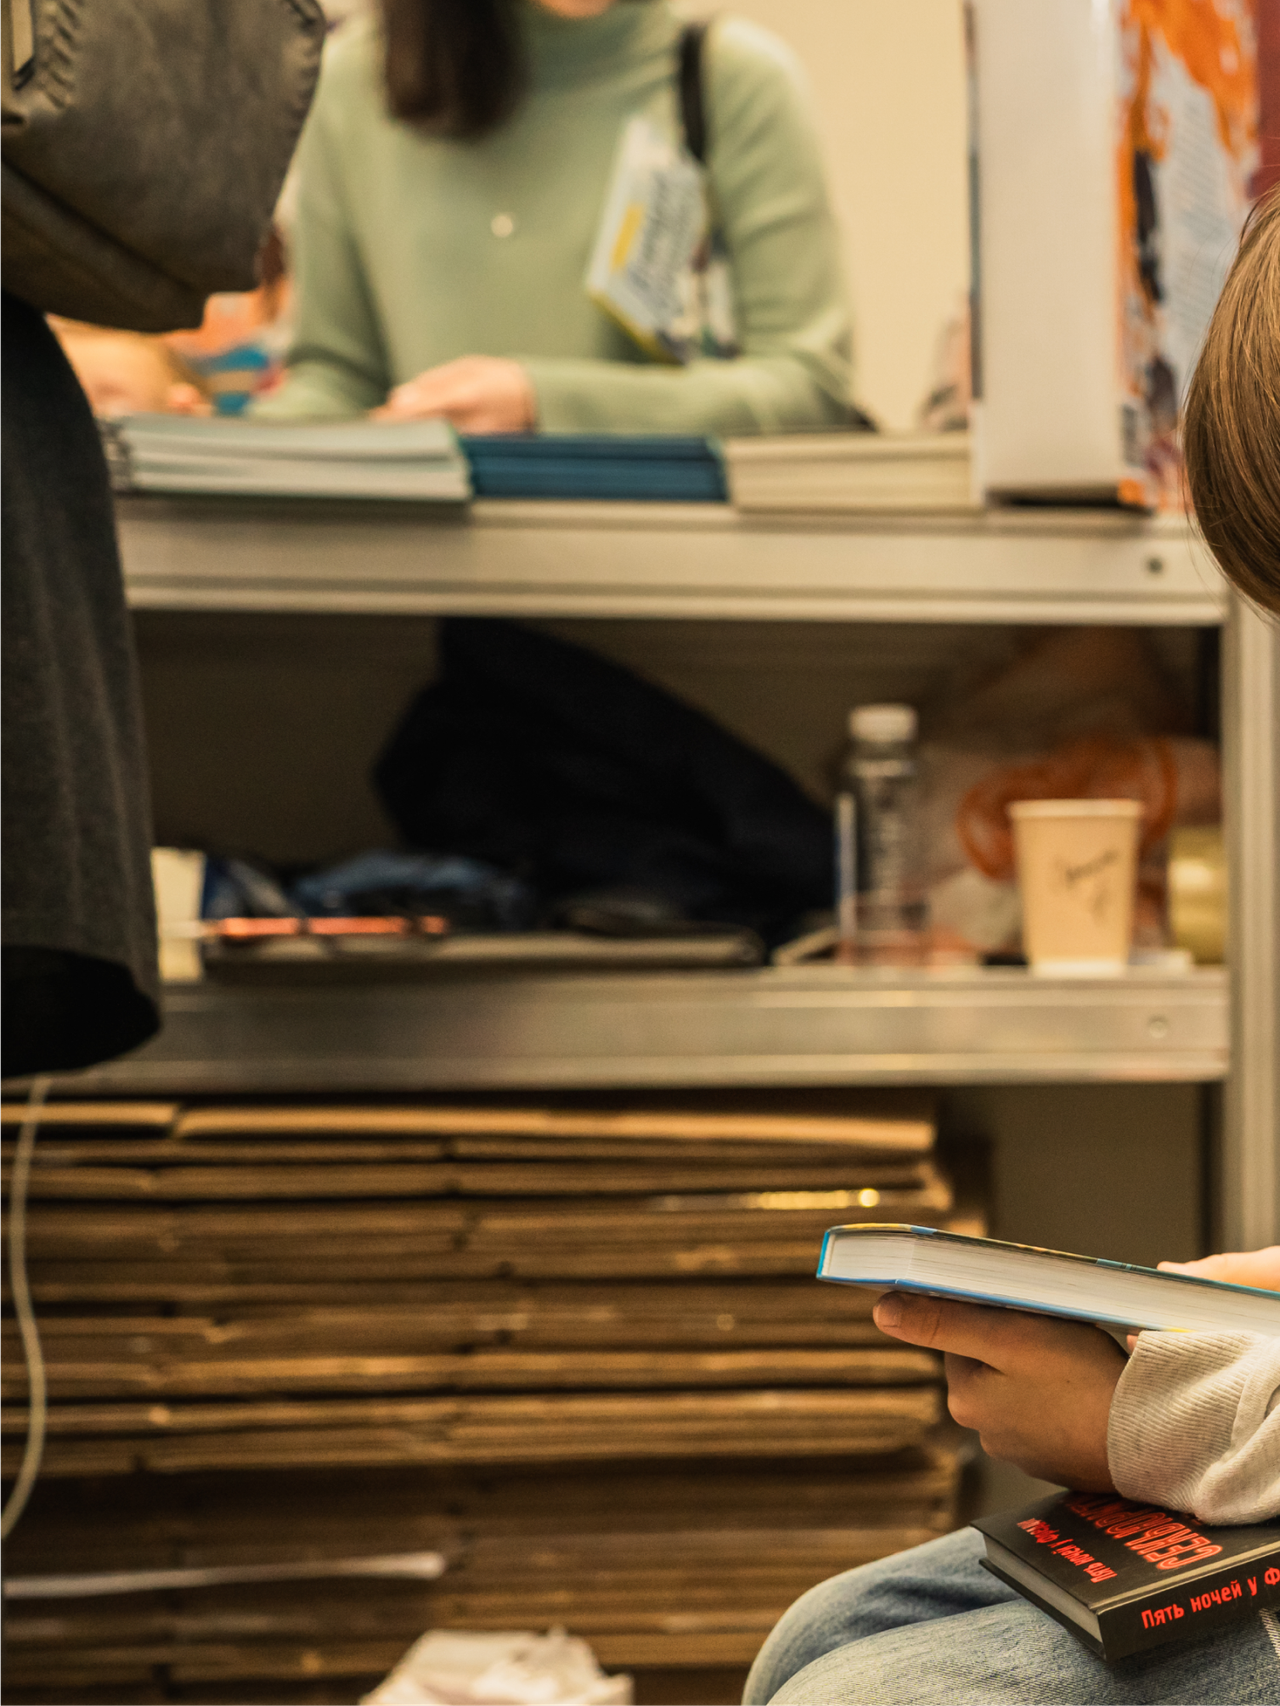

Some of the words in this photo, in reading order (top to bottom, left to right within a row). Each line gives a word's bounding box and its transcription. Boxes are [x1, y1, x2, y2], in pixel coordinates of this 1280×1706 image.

[1047, 1538, 1074, 1549] у
[1051, 1544, 1095, 1566] ночей
[1083, 1562, 1118, 1584] Пять
[1141, 1603, 1185, 1629] Пять
[1189, 1579, 1243, 1613] ночей
[1247, 1575, 1258, 1597] у
